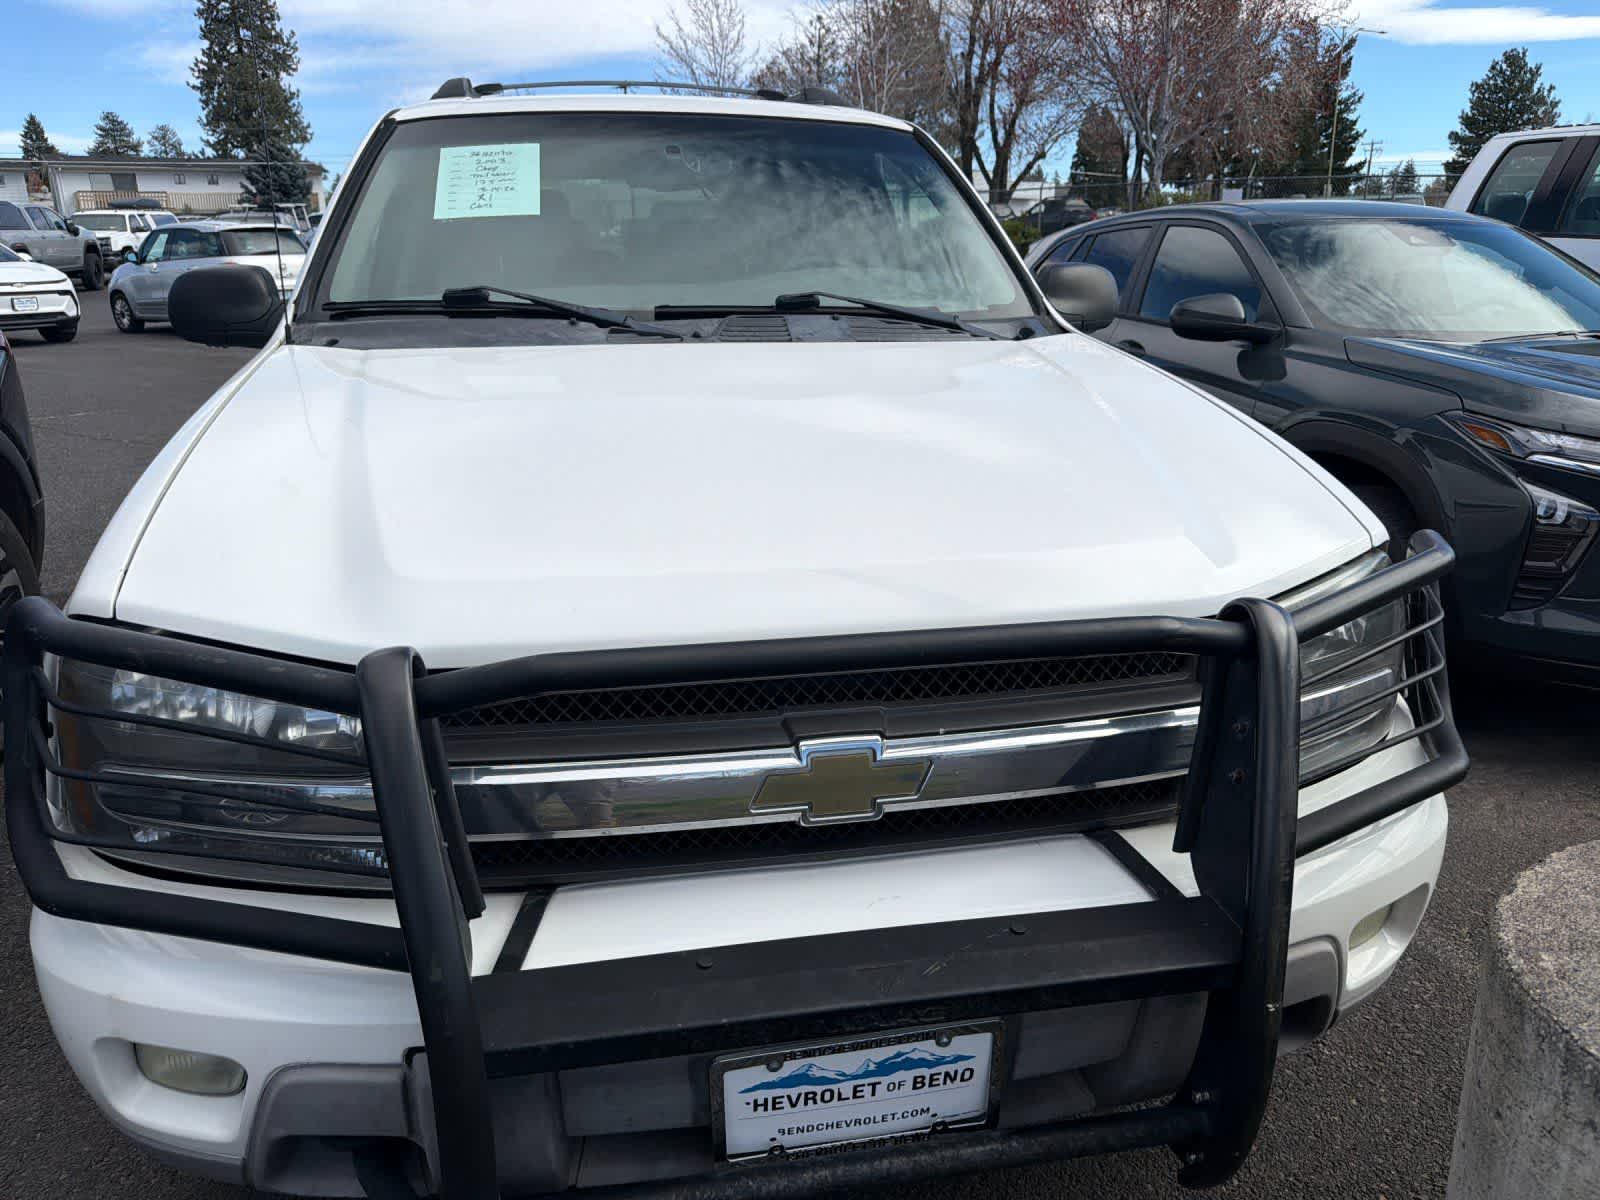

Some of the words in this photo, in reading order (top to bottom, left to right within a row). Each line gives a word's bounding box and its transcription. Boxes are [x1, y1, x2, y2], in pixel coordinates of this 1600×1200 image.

[745, 1080, 882, 1113] HEVROLET
[886, 1079, 906, 1093] OF
[911, 1067, 975, 1091] BEND
